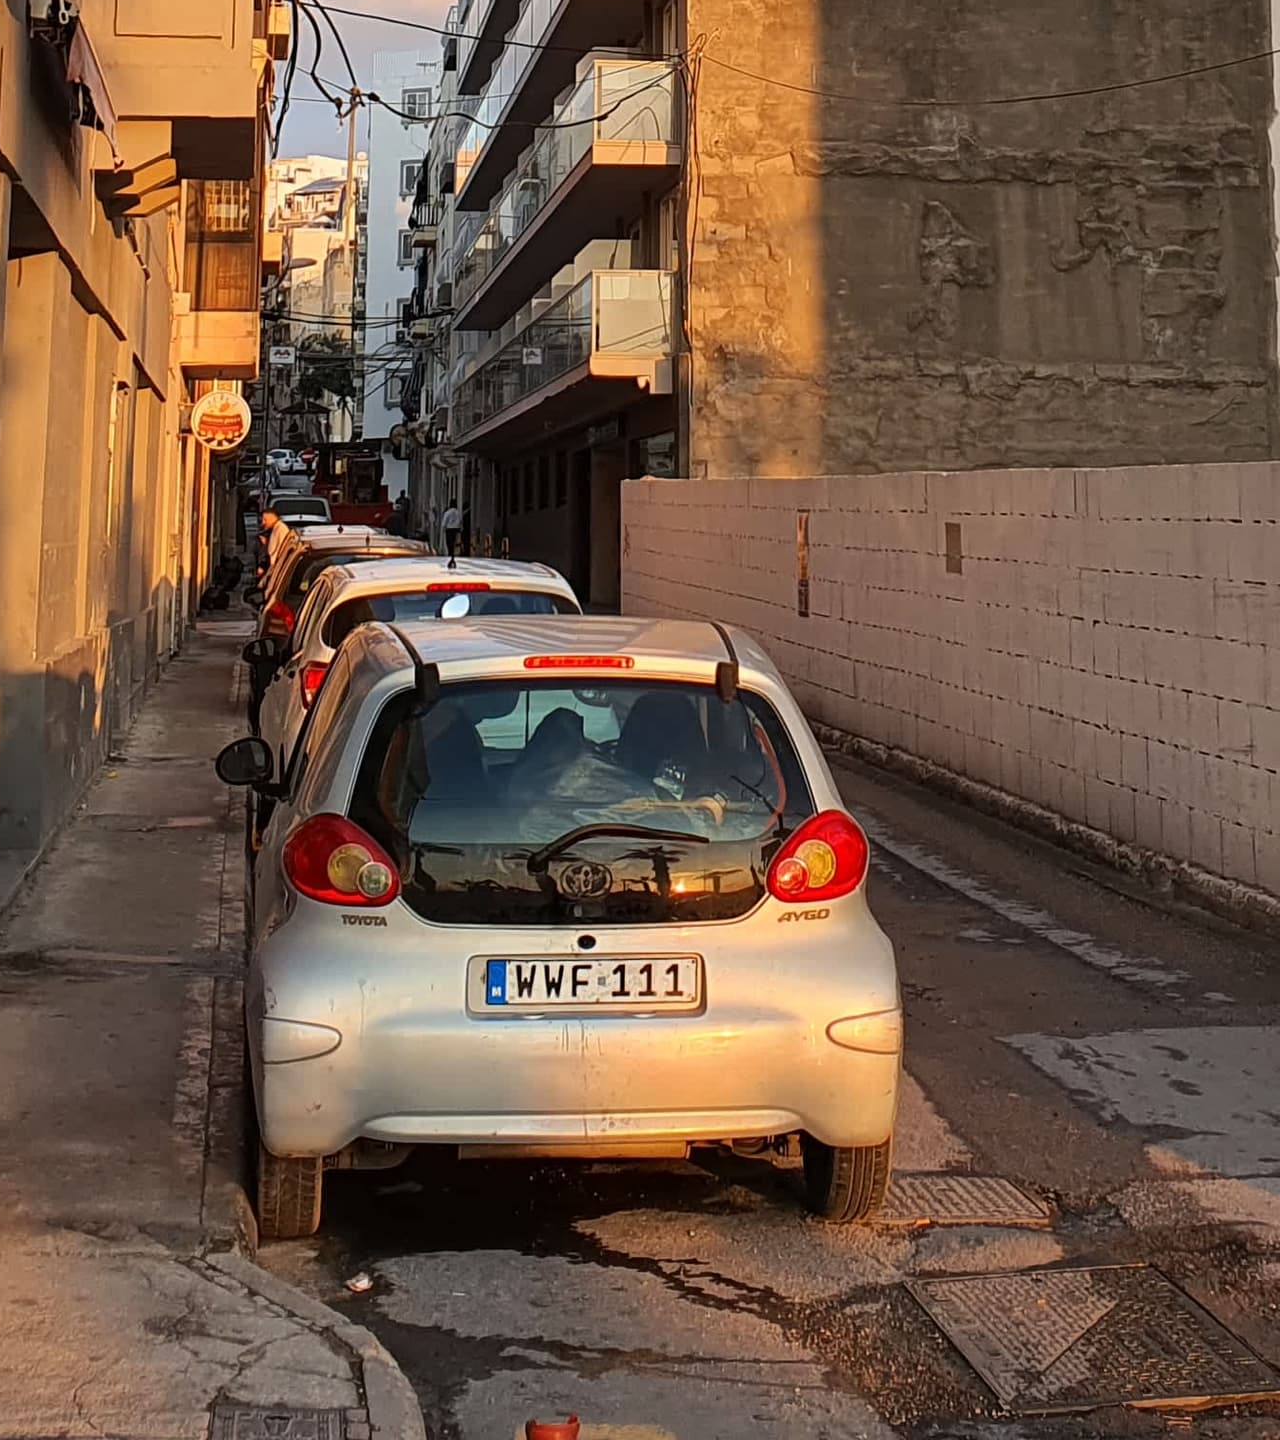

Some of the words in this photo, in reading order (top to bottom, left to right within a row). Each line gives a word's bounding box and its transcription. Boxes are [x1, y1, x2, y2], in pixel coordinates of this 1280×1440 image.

[341, 914, 388, 927] TOYOTA
[777, 908, 830, 923] AYGO
[516, 964, 592, 998] WWF
[611, 963, 683, 997] 111
